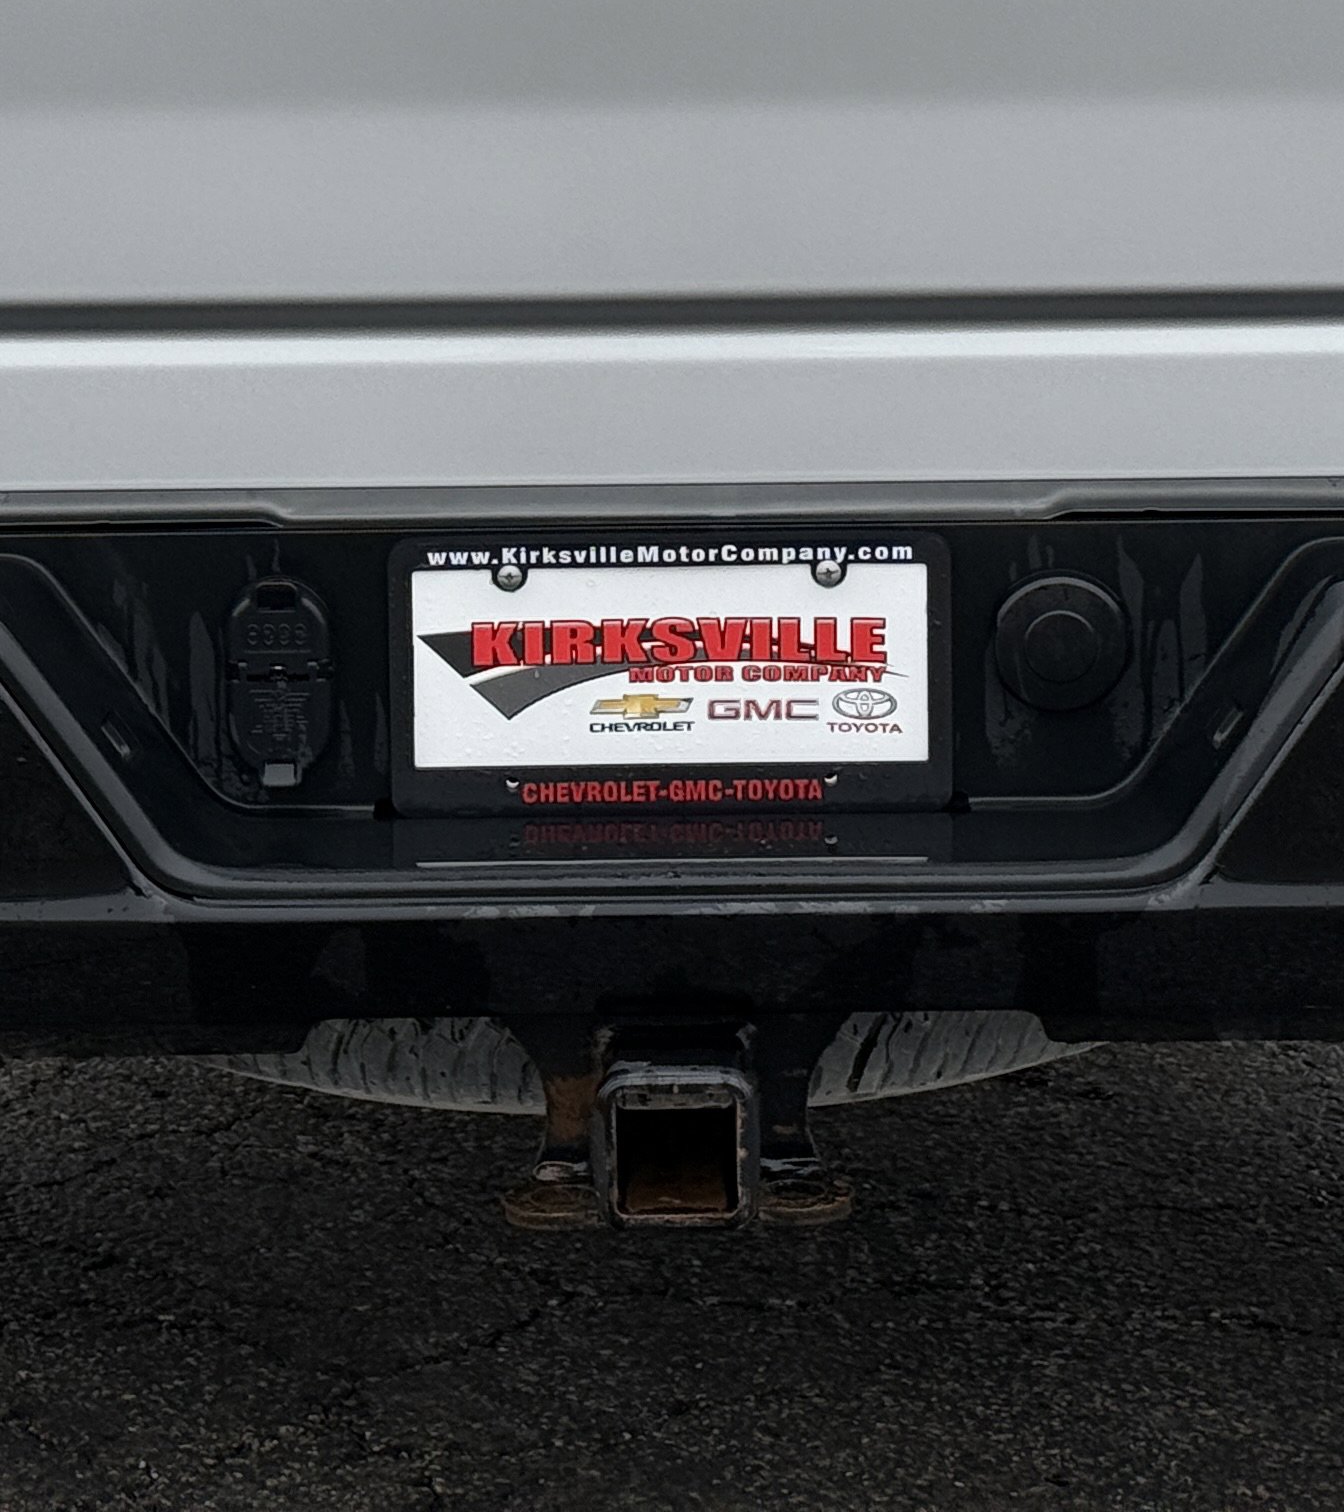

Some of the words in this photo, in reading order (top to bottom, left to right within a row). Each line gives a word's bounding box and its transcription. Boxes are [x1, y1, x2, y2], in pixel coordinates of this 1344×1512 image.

[426, 541, 915, 567] www.KirksvilleMotorCompany.com
[470, 616, 888, 668] KIRKSVILLE
[627, 665, 732, 685] MOTOR
[740, 664, 887, 684] COMPANY
[706, 698, 821, 723] GMC
[588, 719, 696, 734] CHEVROLET
[826, 720, 905, 736] TOYOTA
[521, 777, 824, 805] CHEVROLET-GMC-TOYOTA
